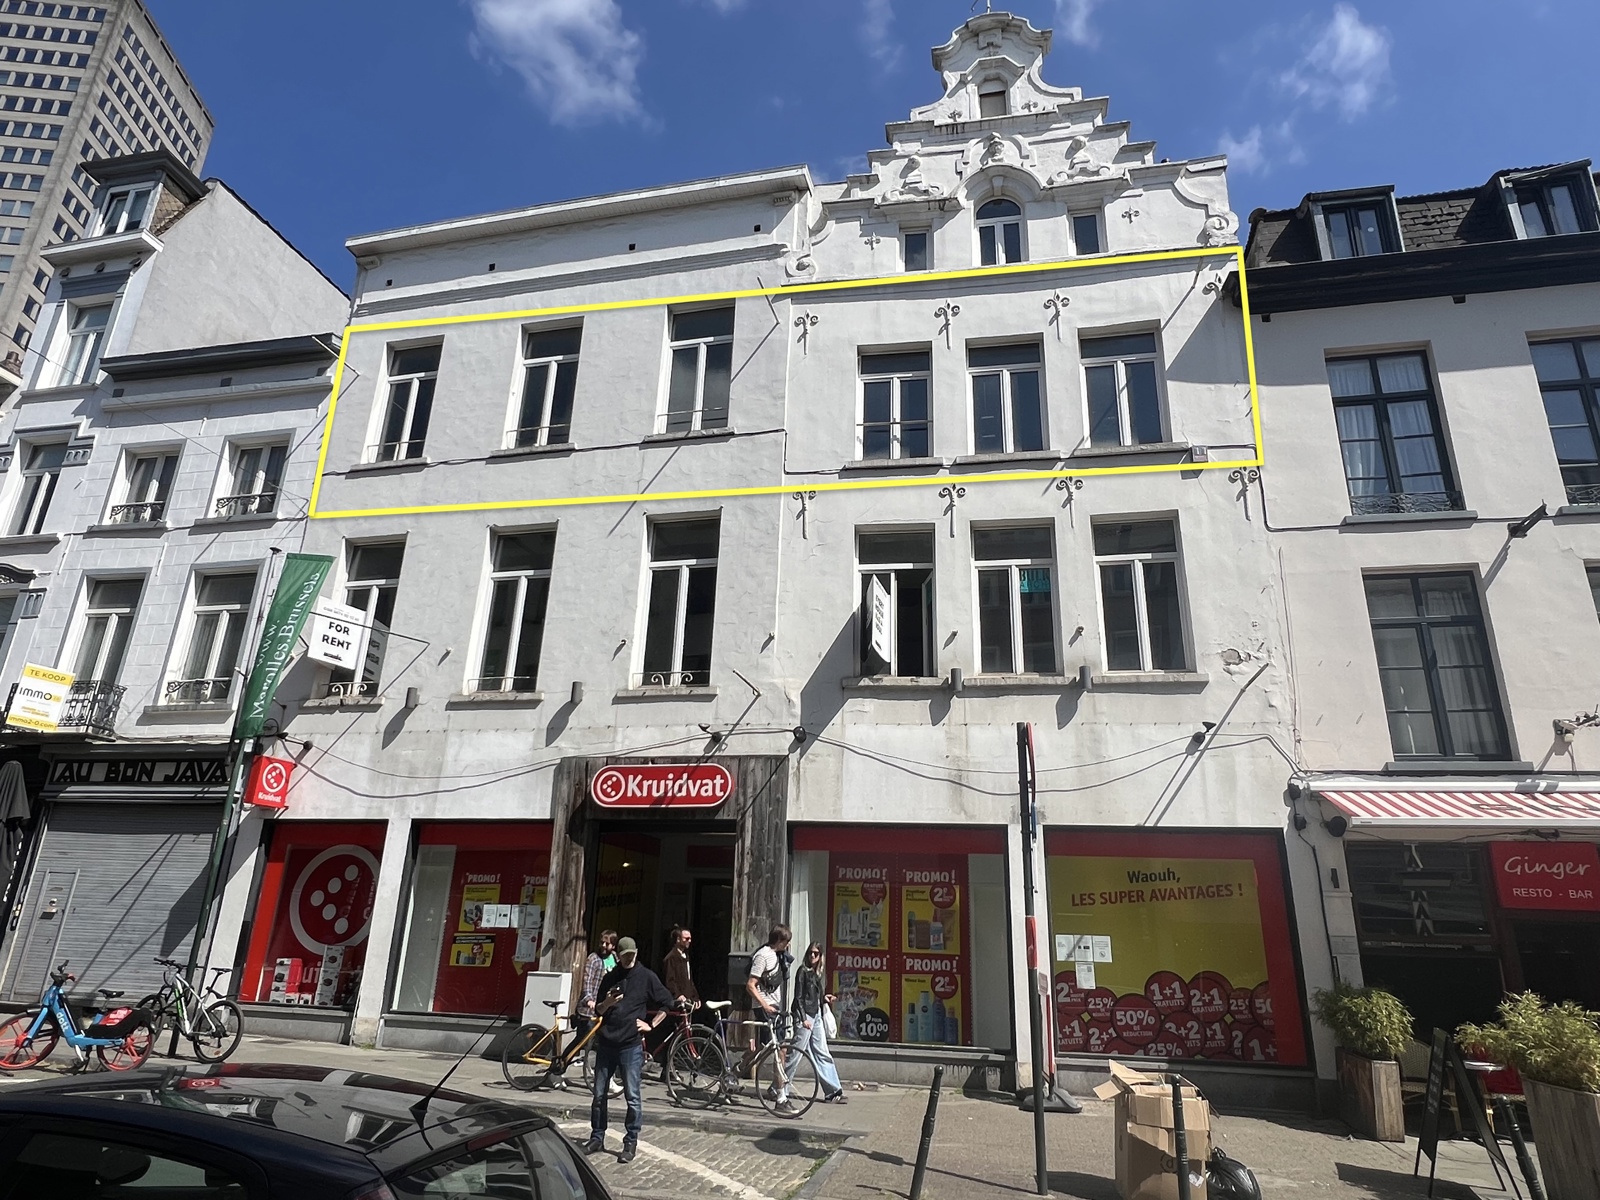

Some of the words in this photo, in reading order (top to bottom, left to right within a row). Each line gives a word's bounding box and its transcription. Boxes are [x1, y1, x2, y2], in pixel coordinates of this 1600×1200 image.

[328, 621, 350, 636] FOR
[250, 572, 320, 718] Marolles.Brussels
[256, 619, 281, 668] www.
[321, 634, 352, 651] RENT
[30, 668, 40, 677] TE
[42, 672, 66, 682] KOOP
[58, 759, 94, 783] AU
[104, 760, 153, 782] BON
[162, 760, 229, 782] JAVA
[626, 772, 725, 798] Kruidvat
[257, 791, 282, 803] Kruidvat
[1127, 867, 1181, 884] Waouh,
[1504, 856, 1591, 880] Ginger
[524, 876, 548, 885] PROM
[1071, 892, 1096, 907] LES
[1099, 889, 1146, 905] SUPER
[1149, 883, 1234, 902] AVANTAGES
[1512, 887, 1553, 898] RESTO
[1568, 889, 1594, 899] BAR
[1150, 981, 1184, 1001] 1+1
[1189, 987, 1222, 1007] 2+1
[1115, 1010, 1156, 1026] 50%
[1192, 1004, 1224, 1014] GRATUITS
[56, 1011, 69, 1033] dott
[1058, 1020, 1083, 1038] +1
[1088, 1026, 1117, 1045] 2+1
[1147, 1042, 1183, 1056] 25%
